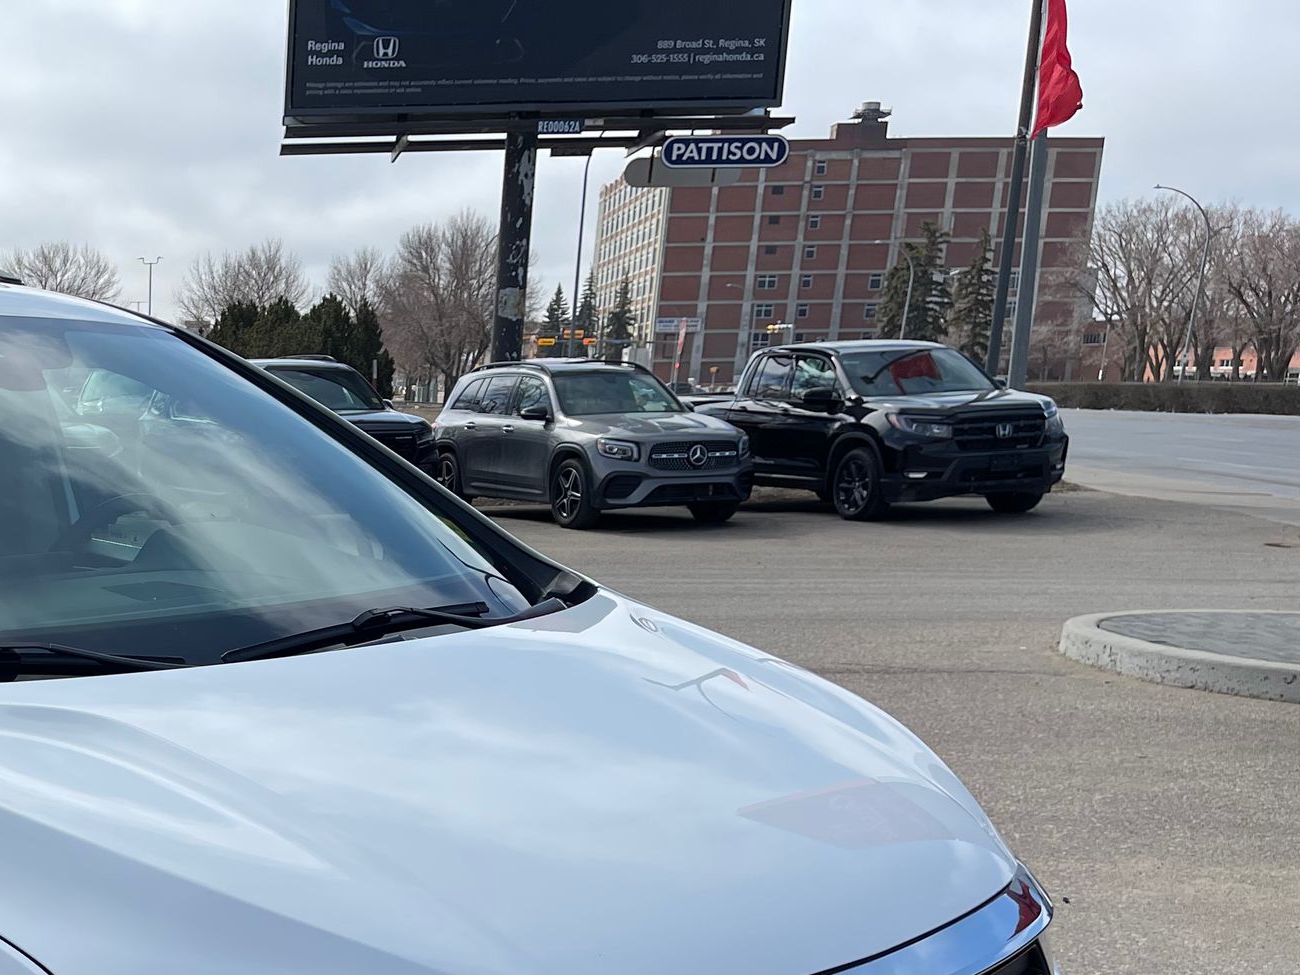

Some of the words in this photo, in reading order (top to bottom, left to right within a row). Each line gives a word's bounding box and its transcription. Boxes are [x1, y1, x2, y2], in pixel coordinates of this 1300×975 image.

[307, 40, 345, 53] Regina
[657, 40, 674, 49] 889
[675, 39, 703, 49] Broad
[753, 38, 766, 48] SK
[307, 54, 343, 66] Honda
[630, 53, 689, 64] 306-525-1555
[695, 51, 765, 64] reginahonda.ca
[363, 60, 407, 69] HONDA
[671, 141, 780, 161] PATTISON
